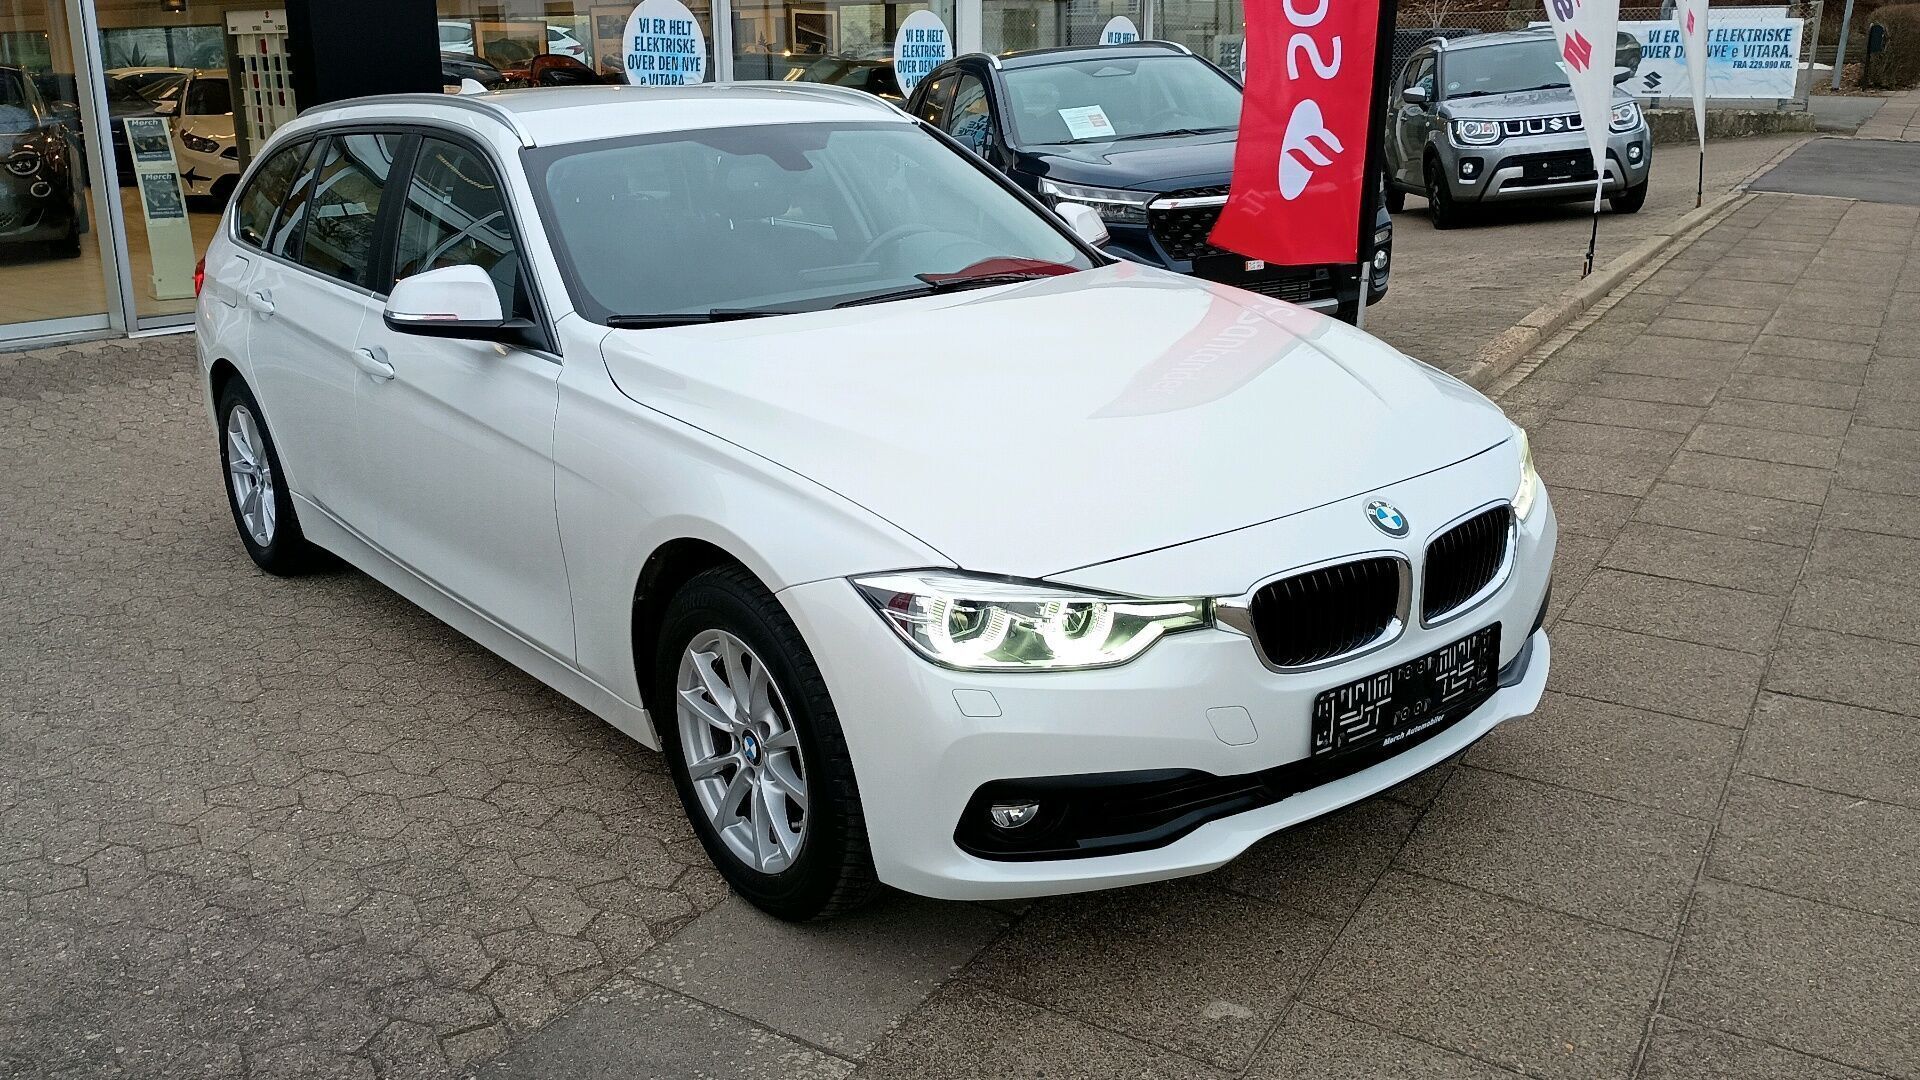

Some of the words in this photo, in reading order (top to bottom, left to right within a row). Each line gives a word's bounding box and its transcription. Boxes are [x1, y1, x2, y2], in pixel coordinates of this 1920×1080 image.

[639, 17, 649, 34] VI
[653, 18, 666, 35] ER
[669, 20, 692, 36] HELT
[906, 29, 913, 43] VI
[916, 30, 925, 43] ER
[927, 30, 943, 43] HELT
[1648, 30, 1660, 43] VI
[1663, 29, 1679, 43] ER
[1716, 28, 1792, 42] ELEKTRISKE
[634, 36, 695, 54] ELEKTRISKE
[902, 45, 945, 58] ELEKTRISKE
[1641, 45, 1671, 58] OVER
[1732, 47, 1738, 58] e
[1743, 44, 1793, 58] VITARA.
[628, 54, 655, 71] OVER
[658, 56, 679, 71] DEN
[682, 57, 701, 72] NYE
[897, 60, 916, 73] OVER
[1733, 60, 1747, 69] FRA
[1749, 60, 1779, 69] 229.990
[1780, 60, 1793, 69] KR.
[640, 76, 647, 85] e
[648, 73, 685, 85] VITARA
[906, 78, 911, 88] e
[1406, 714, 1445, 737] Automobiler
